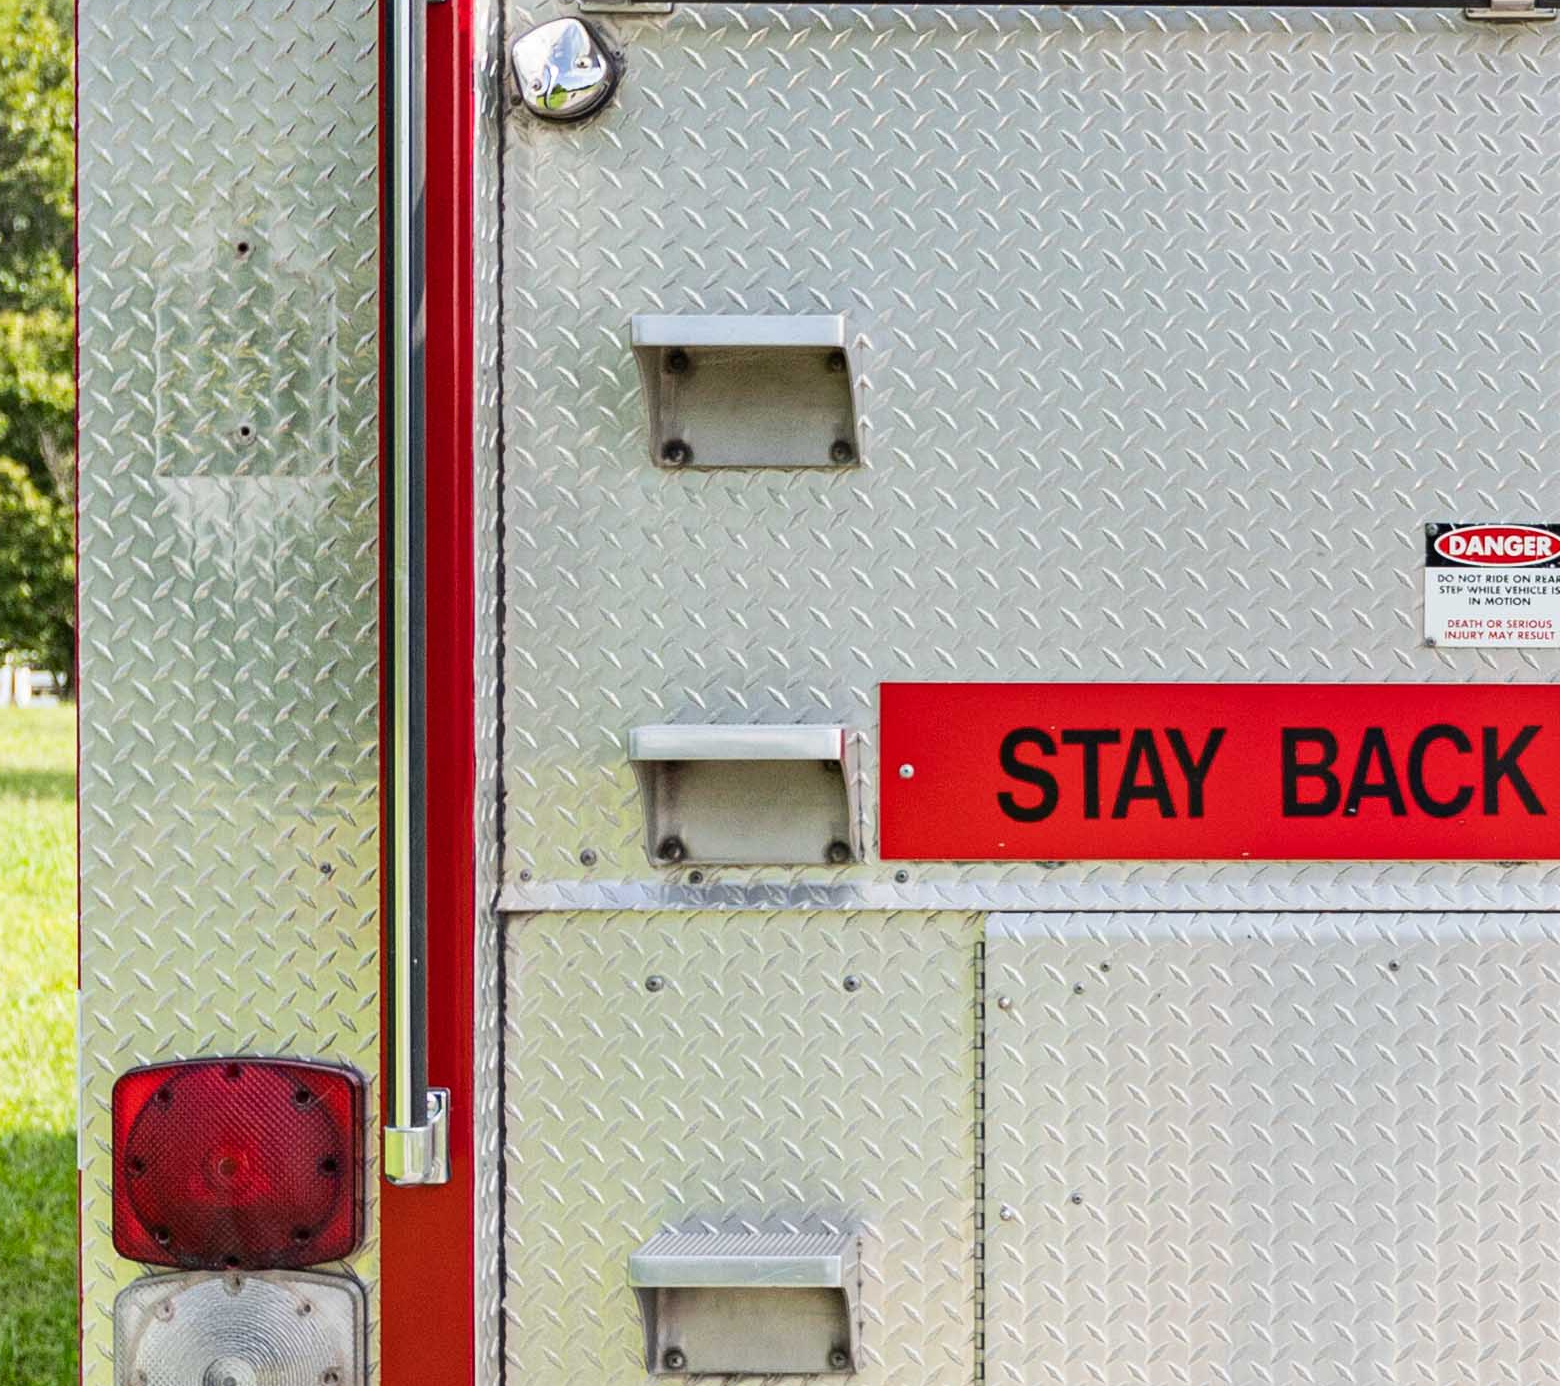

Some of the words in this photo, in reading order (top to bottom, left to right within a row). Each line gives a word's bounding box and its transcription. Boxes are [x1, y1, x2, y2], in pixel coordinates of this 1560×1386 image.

[1449, 535, 1553, 557] DANGER
[1437, 574, 1454, 583] DO
[1458, 574, 1482, 583] NOT
[1485, 574, 1509, 583] RIDE
[1513, 574, 1531, 583] ON
[1439, 586, 1463, 594] STEP
[1467, 586, 1501, 594] WHILE
[1505, 586, 1547, 594] VEHICLE
[1551, 586, 1560, 594] IS
[1468, 597, 1481, 606] IN
[1484, 597, 1531, 606] MOTION
[1447, 619, 1482, 628] DEATH
[1486, 619, 1502, 628] OR
[1506, 619, 1553, 628] SERIOUS
[1444, 631, 1484, 640] INJURY
[1488, 631, 1513, 640] MAY
[1517, 631, 1555, 640] RESULT
[995, 726, 1227, 822] STAY
[1280, 724, 1546, 817] BACK
